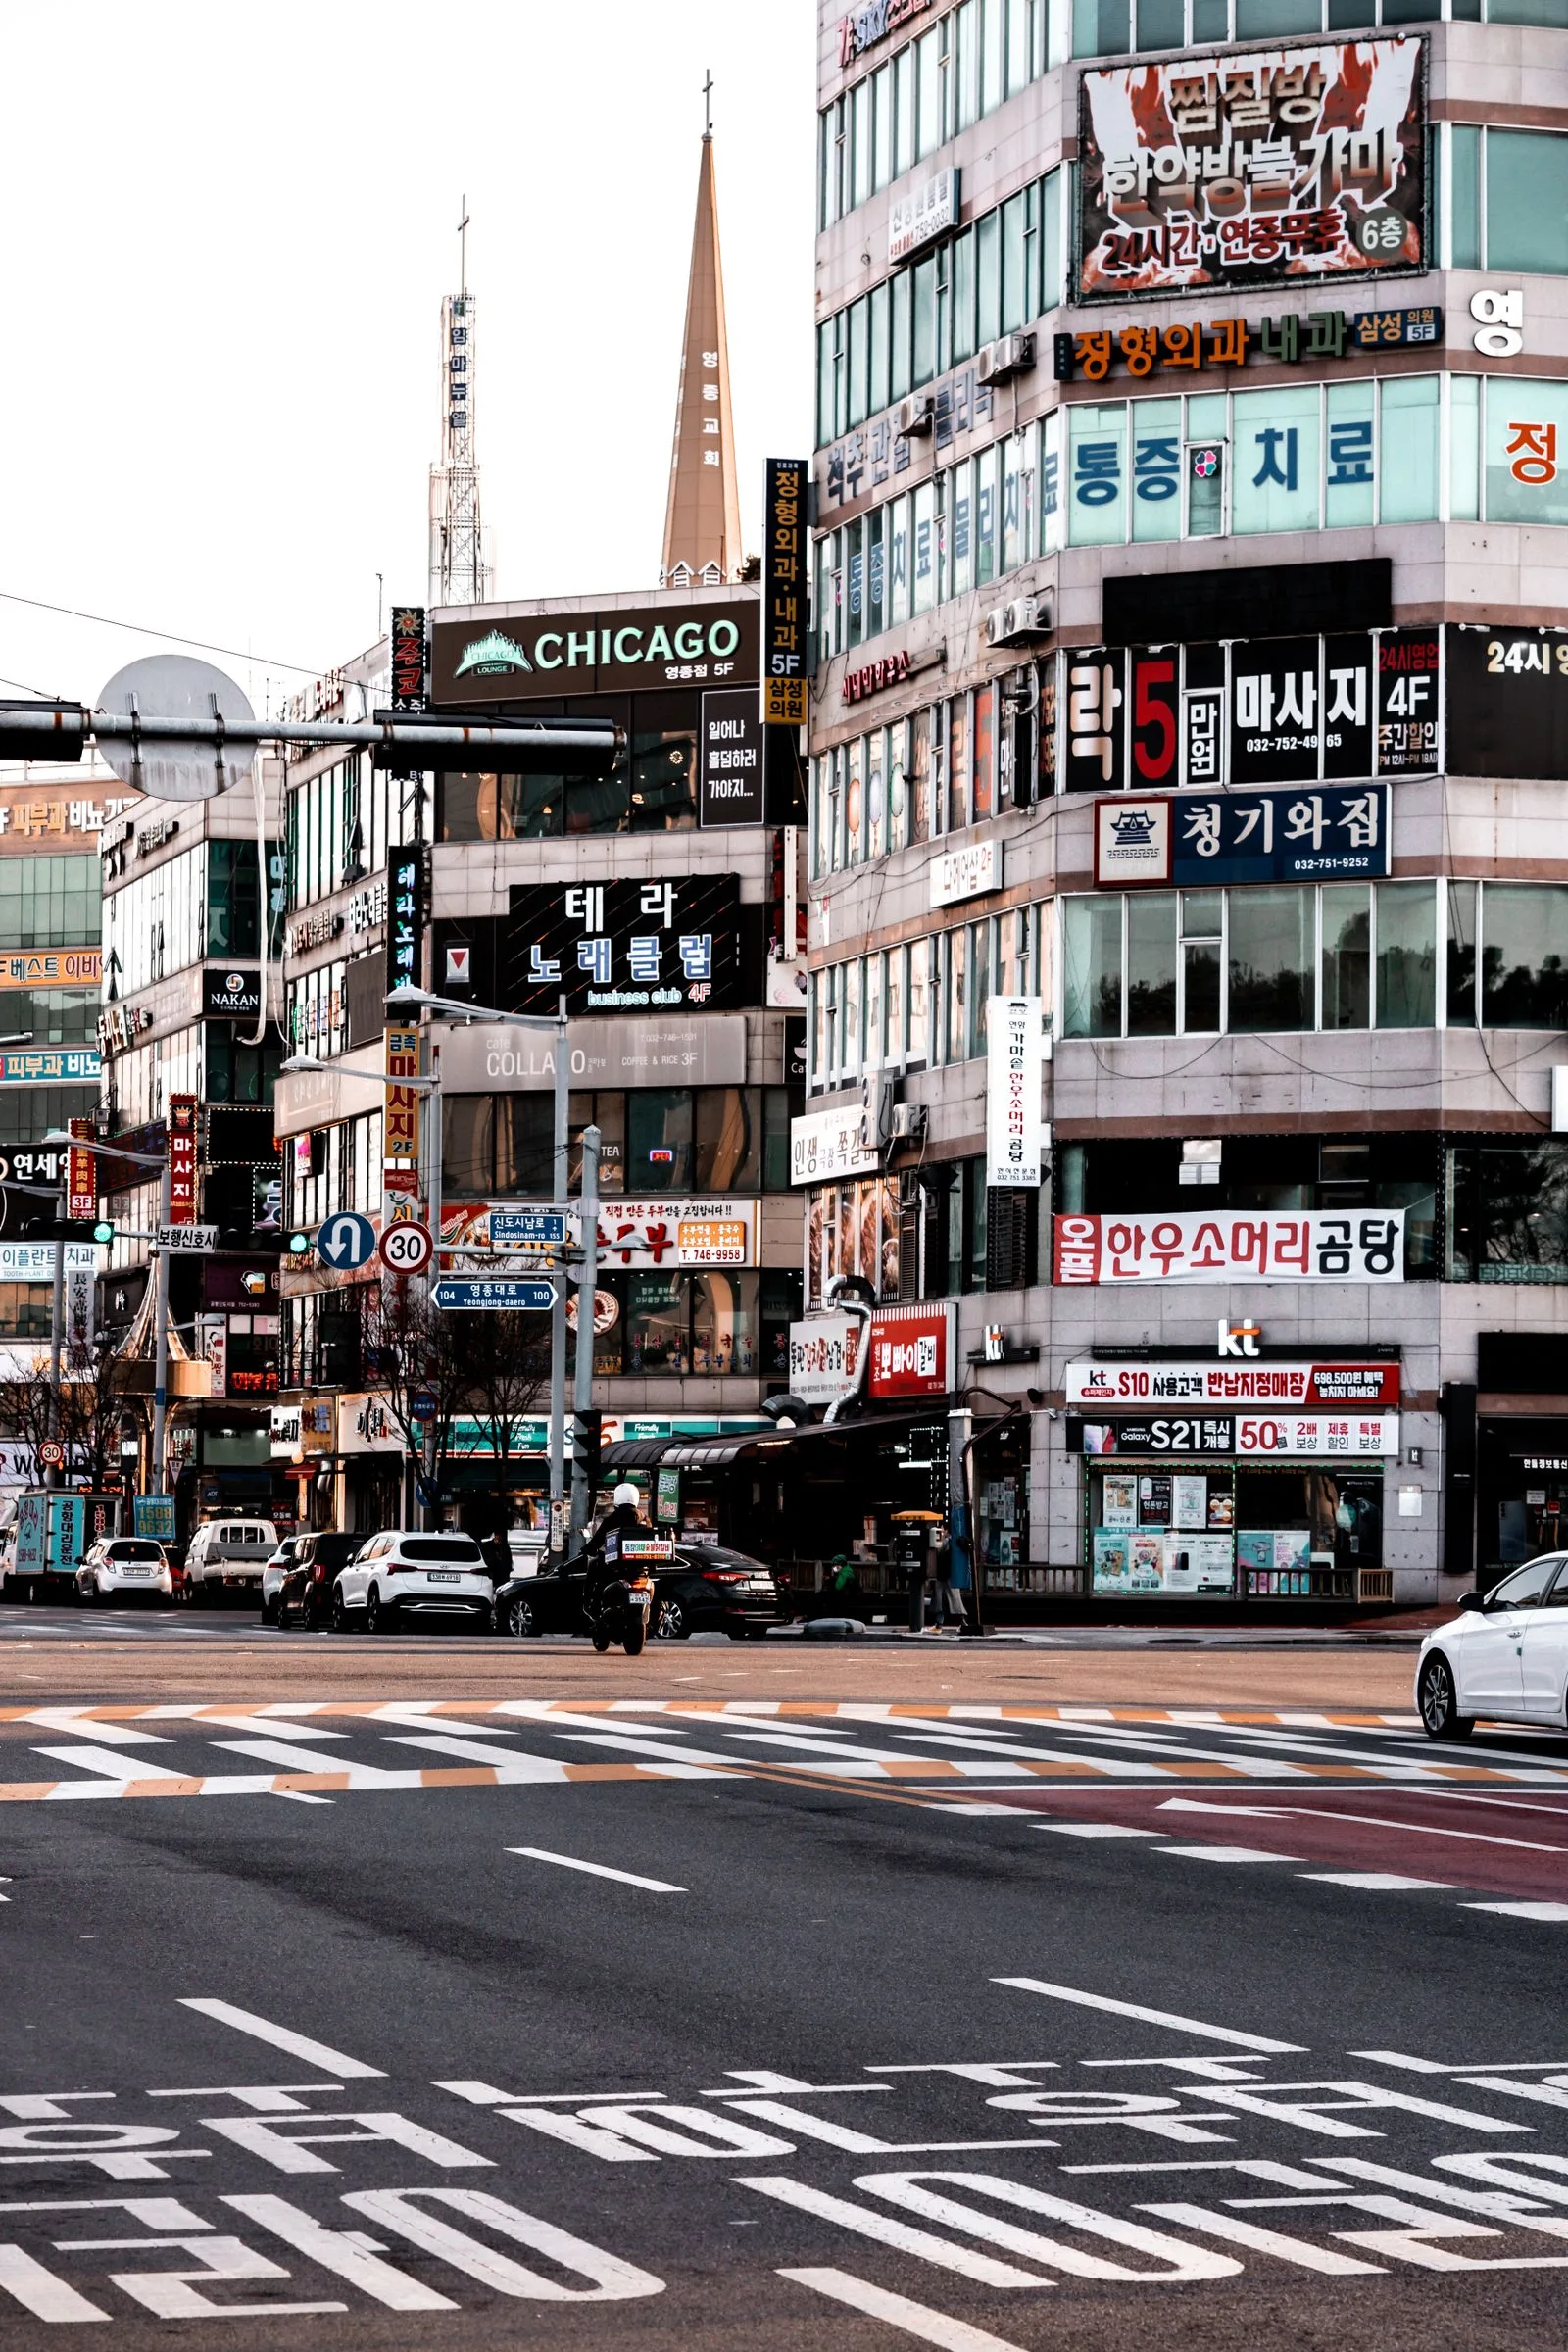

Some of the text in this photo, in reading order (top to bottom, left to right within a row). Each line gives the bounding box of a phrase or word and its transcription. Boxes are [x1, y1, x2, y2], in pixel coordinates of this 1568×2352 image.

[1170, 62, 1326, 134] 찜질방
[1102, 210, 1346, 269] 24시간 연중무휴
[1361, 216, 1403, 250] 6층
[1407, 308, 1435, 324] 의원
[1470, 290, 1523, 357] 영
[1412, 325, 1433, 340] 5F
[1075, 318, 1250, 381] 정형외과
[1261, 310, 1348, 362] 내과
[1357, 314, 1402, 343] 삼성
[1506, 422, 1558, 486] 정
[1075, 421, 1373, 507] 통증 치료
[773, 471, 799, 651] 정형외과 내과
[851, 519, 930, 612] 통증치료
[534, 619, 739, 669] CHICAGO
[477, 665, 508, 674] LOUNGE
[665, 662, 734, 679] 영종점 5F
[771, 654, 800, 675] 5F
[769, 680, 802, 699] 삼성
[1387, 676, 1431, 716] 4F
[769, 700, 802, 719] 의원
[1237, 667, 1368, 734] 마사지
[1071, 666, 1122, 780] 락
[1135, 662, 1176, 780] 5
[709, 721, 745, 741] 일어나
[1190, 702, 1218, 777] 만원
[1379, 722, 1439, 751] 주간할인
[1247, 734, 1343, 753] 032-752-4965
[708, 750, 756, 769] 홀덤하러
[12, 802, 69, 835] 피부과
[1183, 785, 1378, 857] 청기와집
[1294, 856, 1370, 871] 032-751-9252
[565, 883, 679, 932] 테라
[527, 933, 713, 983] 노래클럽
[11, 956, 59, 983] 베스트
[211, 993, 259, 1005] NAKAN
[588, 983, 712, 1007] business club 4F
[486, 1035, 511, 1050] cafe
[7, 1055, 64, 1078] 피부과
[486, 1049, 586, 1077] COLLAO
[622, 1055, 648, 1066] COFFEE
[662, 1054, 678, 1065] RICE
[681, 1052, 698, 1066] 3F
[392, 1141, 413, 1153] 2F
[601, 1146, 619, 1156] TEA
[173, 1138, 193, 1197] 마사지
[74, 1197, 89, 1208] 3F
[605, 1204, 623, 1218] 직접
[626, 1204, 644, 1217] 만든
[494, 1217, 546, 1229] 신도시남로
[159, 1229, 217, 1250] 보행신호시
[494, 1230, 546, 1240] Sindosinam-ro
[67, 1247, 95, 1266] 치과
[389, 1235, 422, 1261] 30
[682, 1249, 741, 1261] T. 746-9958
[1060, 1217, 1095, 1283] 오픈
[439, 1290, 455, 1300] 104
[469, 1284, 517, 1297] 영종대로
[533, 1290, 550, 1300] 100
[463, 1297, 526, 1307] Yeongjong-daero
[1218, 1318, 1261, 1356] kt
[881, 1342, 918, 1379] 뽀빠이
[919, 1340, 936, 1372] 갈비
[1089, 1370, 1107, 1386] kt
[1119, 1371, 1304, 1397] S10 사용고객 반납지정매장
[1348, 1385, 1379, 1397] 마세요!
[634, 1422, 660, 1434] Friendly
[1121, 1432, 1151, 1443] Galaxy
[1151, 1421, 1202, 1450] S21
[1203, 1421, 1230, 1436] 즉시
[1296, 1422, 1381, 1436] 2배 제휴 특별
[517, 1443, 530, 1451] Fun
[1203, 1436, 1230, 1449] 개통
[1296, 1437, 1381, 1450] 보상 할인 보상
[44, 1447, 60, 1458] 30
[139, 1506, 172, 1519] 1588
[60, 1500, 74, 1566] 공항대리운전
[138, 1520, 172, 1534] 9632
